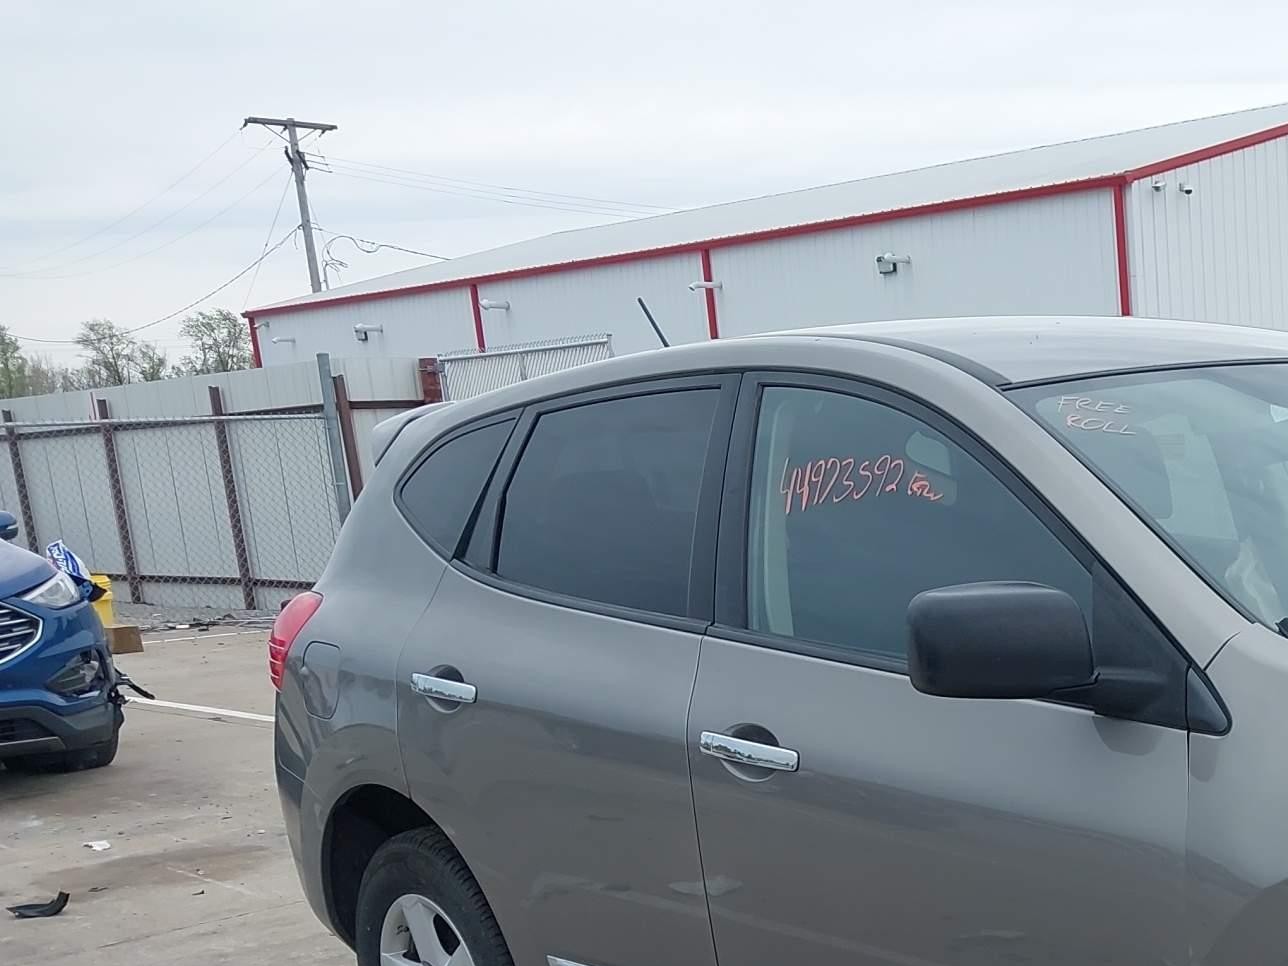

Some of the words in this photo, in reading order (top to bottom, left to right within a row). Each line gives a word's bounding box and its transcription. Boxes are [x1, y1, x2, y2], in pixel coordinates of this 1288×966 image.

[1057, 395, 1130, 414] FREE
[1066, 414, 1137, 435] ROLL
[780, 454, 904, 515] 44973592
